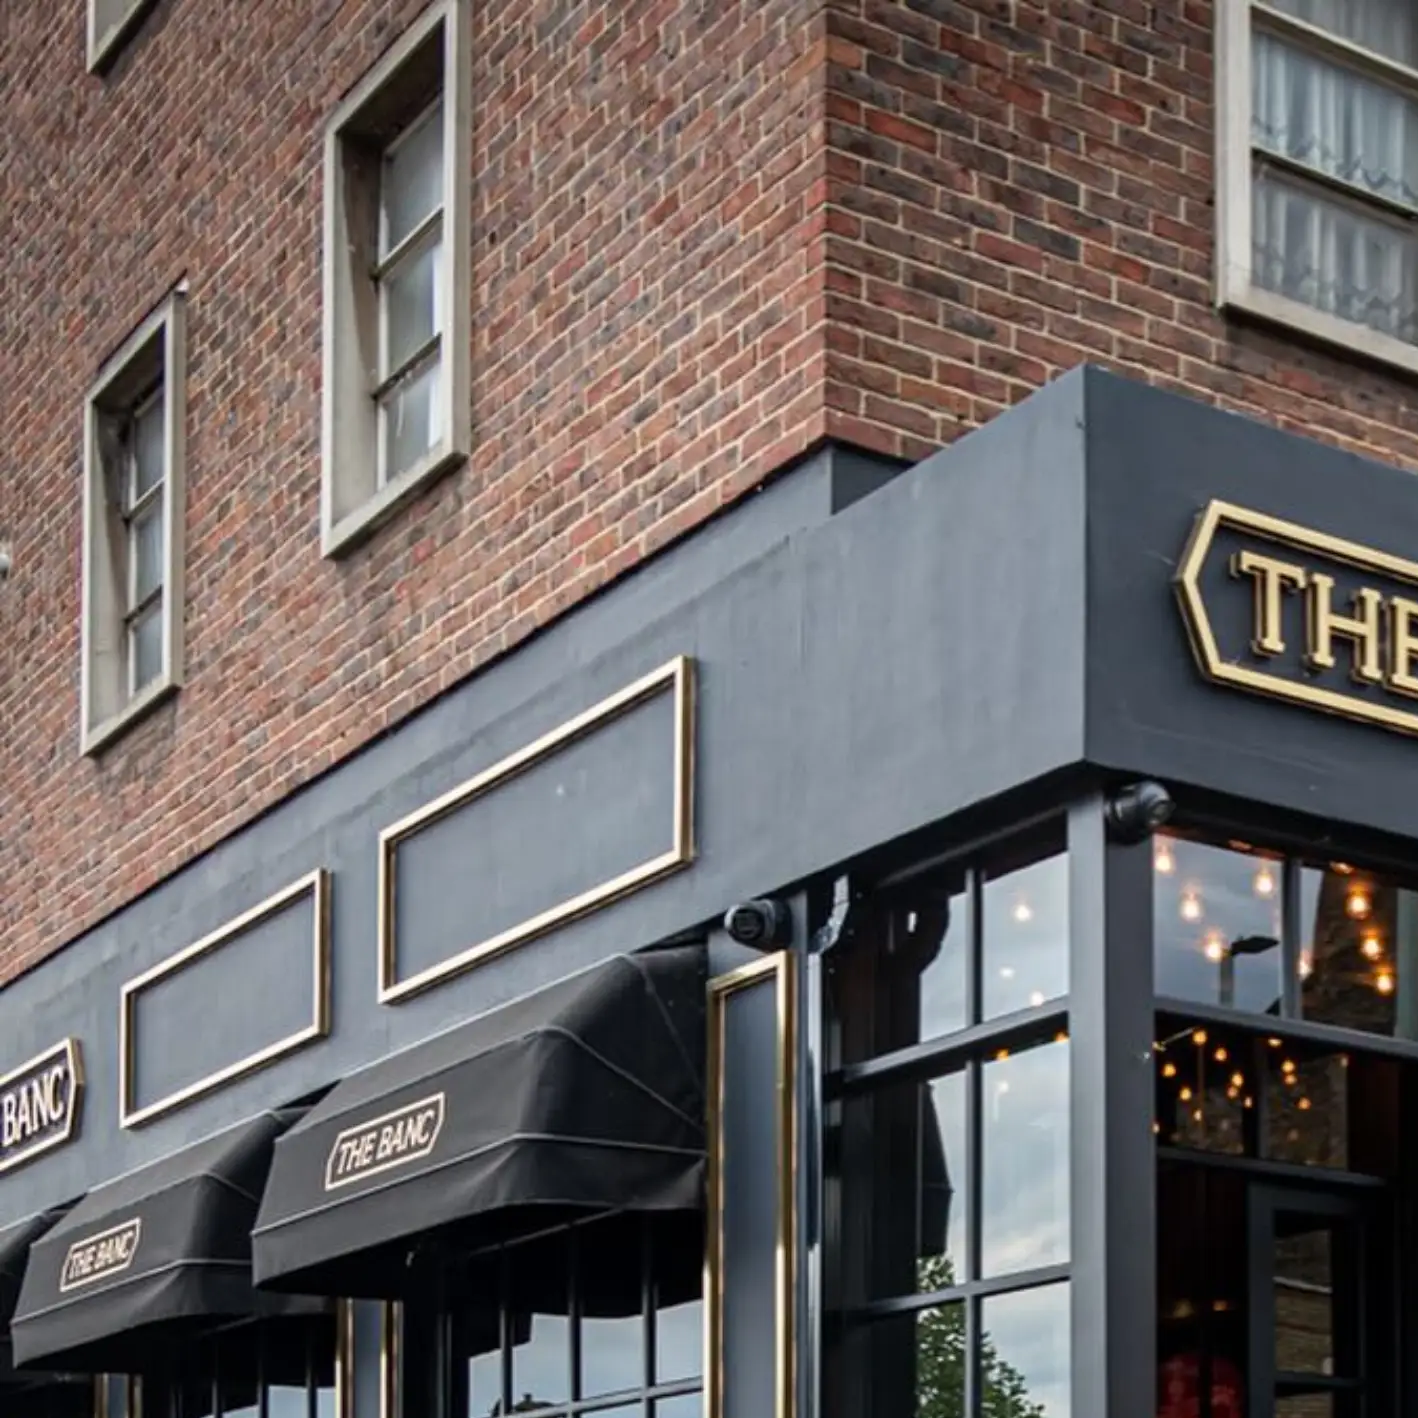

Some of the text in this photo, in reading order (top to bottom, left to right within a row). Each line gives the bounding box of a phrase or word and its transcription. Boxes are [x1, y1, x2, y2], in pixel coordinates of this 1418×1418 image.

[3, 1065, 64, 1147] BANC
[337, 1109, 434, 1175] THE BANC
[69, 1245, 96, 1280] THE
